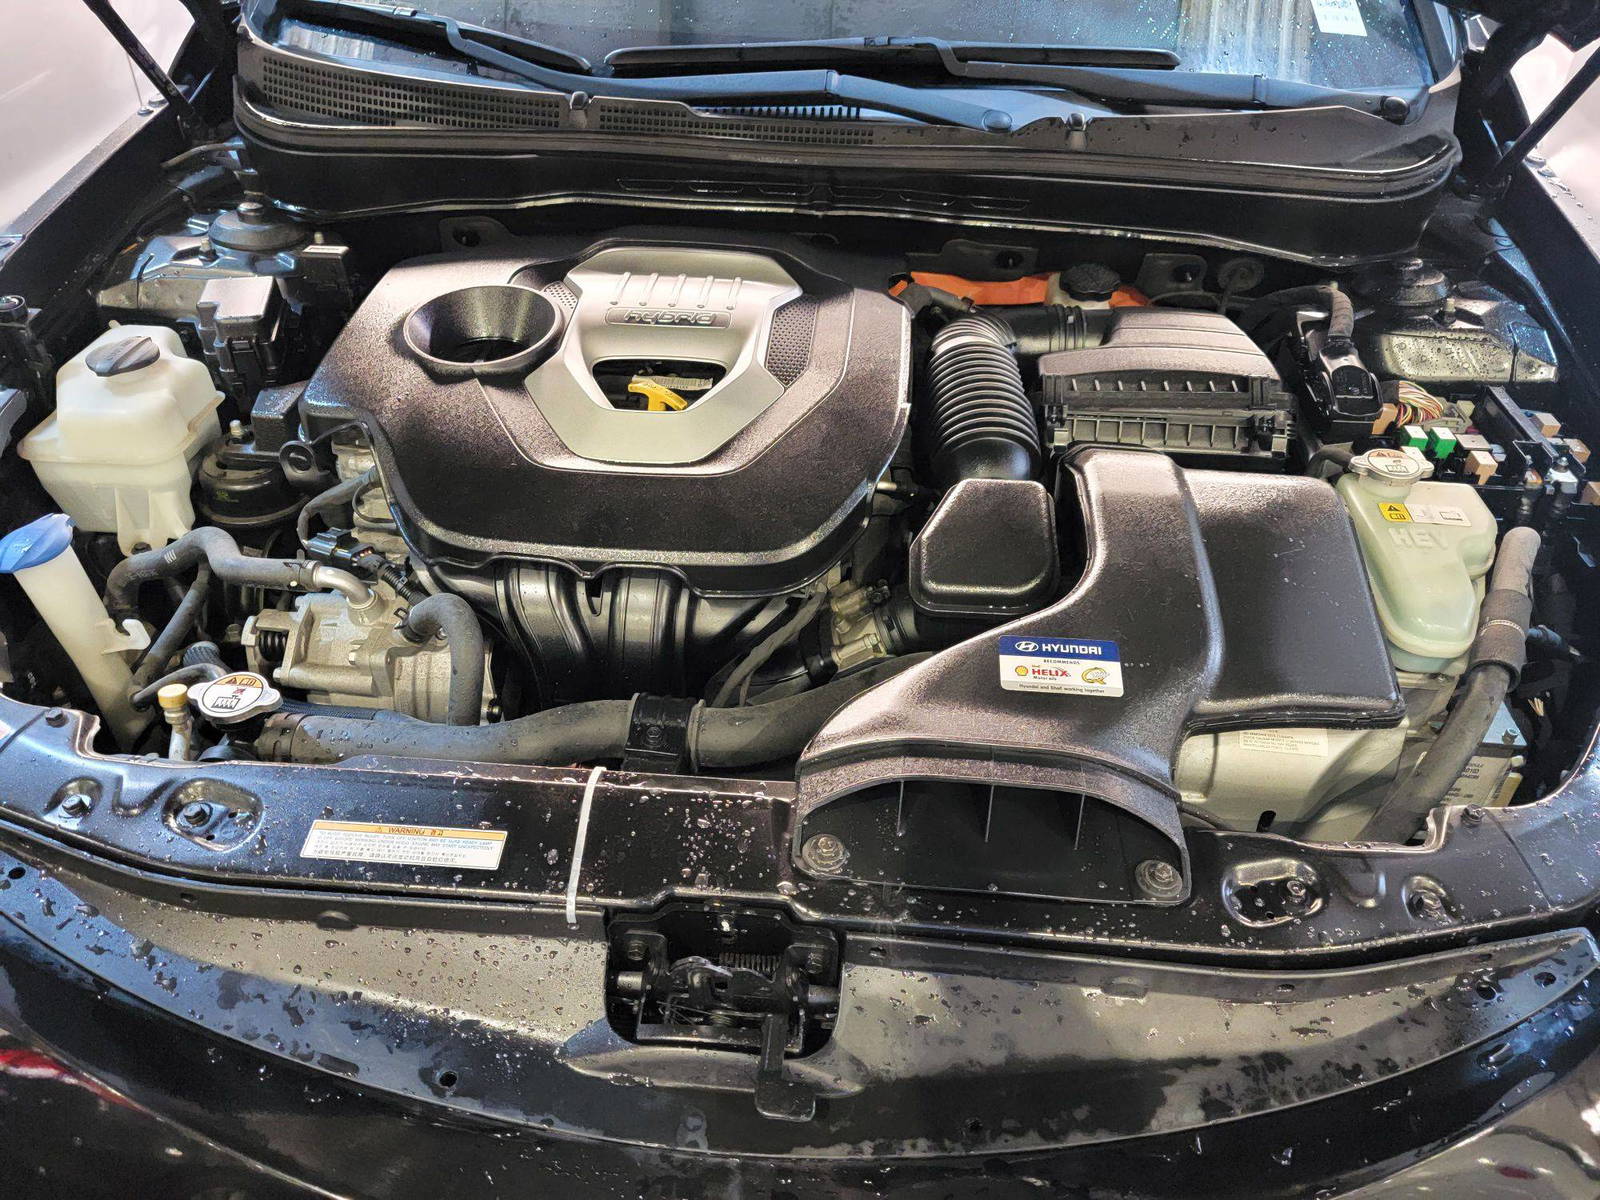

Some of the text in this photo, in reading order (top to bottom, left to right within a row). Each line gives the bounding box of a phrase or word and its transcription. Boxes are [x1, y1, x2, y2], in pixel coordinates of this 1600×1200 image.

[1042, 643, 1102, 655] HYUNDAI
[1031, 668, 1068, 677] HELIX
[388, 826, 426, 835] WARNING
